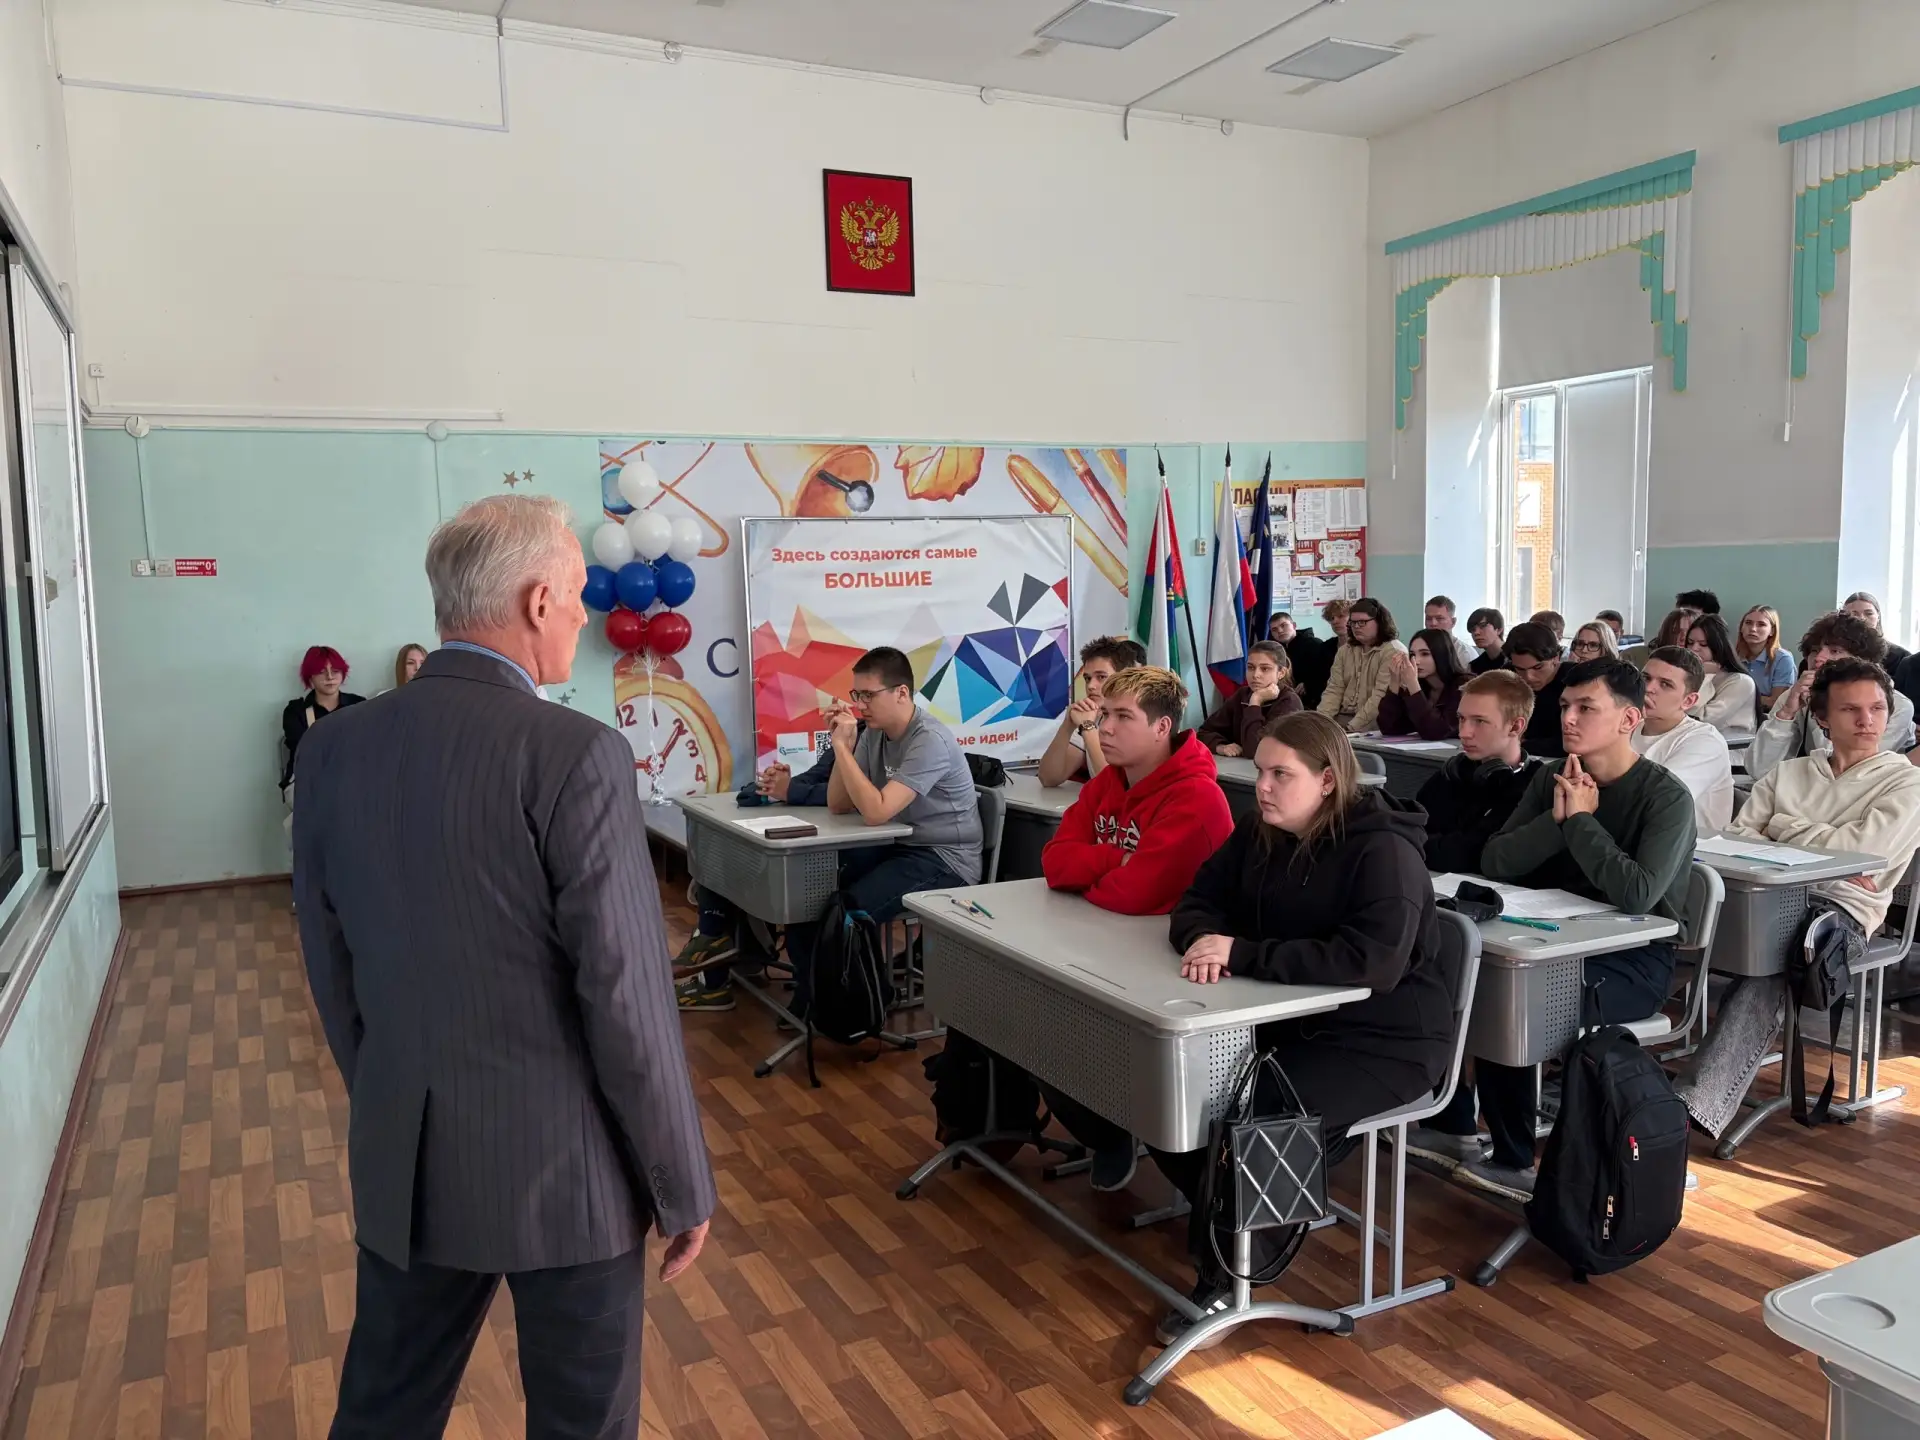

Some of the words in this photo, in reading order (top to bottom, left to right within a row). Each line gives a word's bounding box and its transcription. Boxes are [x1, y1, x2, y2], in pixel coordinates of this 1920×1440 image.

[771, 547, 825, 563] Здесь
[829, 547, 921, 563] создаются
[924, 546, 978, 560] самые
[205, 561, 216, 571] 01
[824, 570, 933, 589] БОЛЬШИЕ
[616, 704, 638, 729] 12
[981, 729, 1018, 745] идеи!
[685, 739, 699, 758] 3
[695, 764, 707, 782] 4
